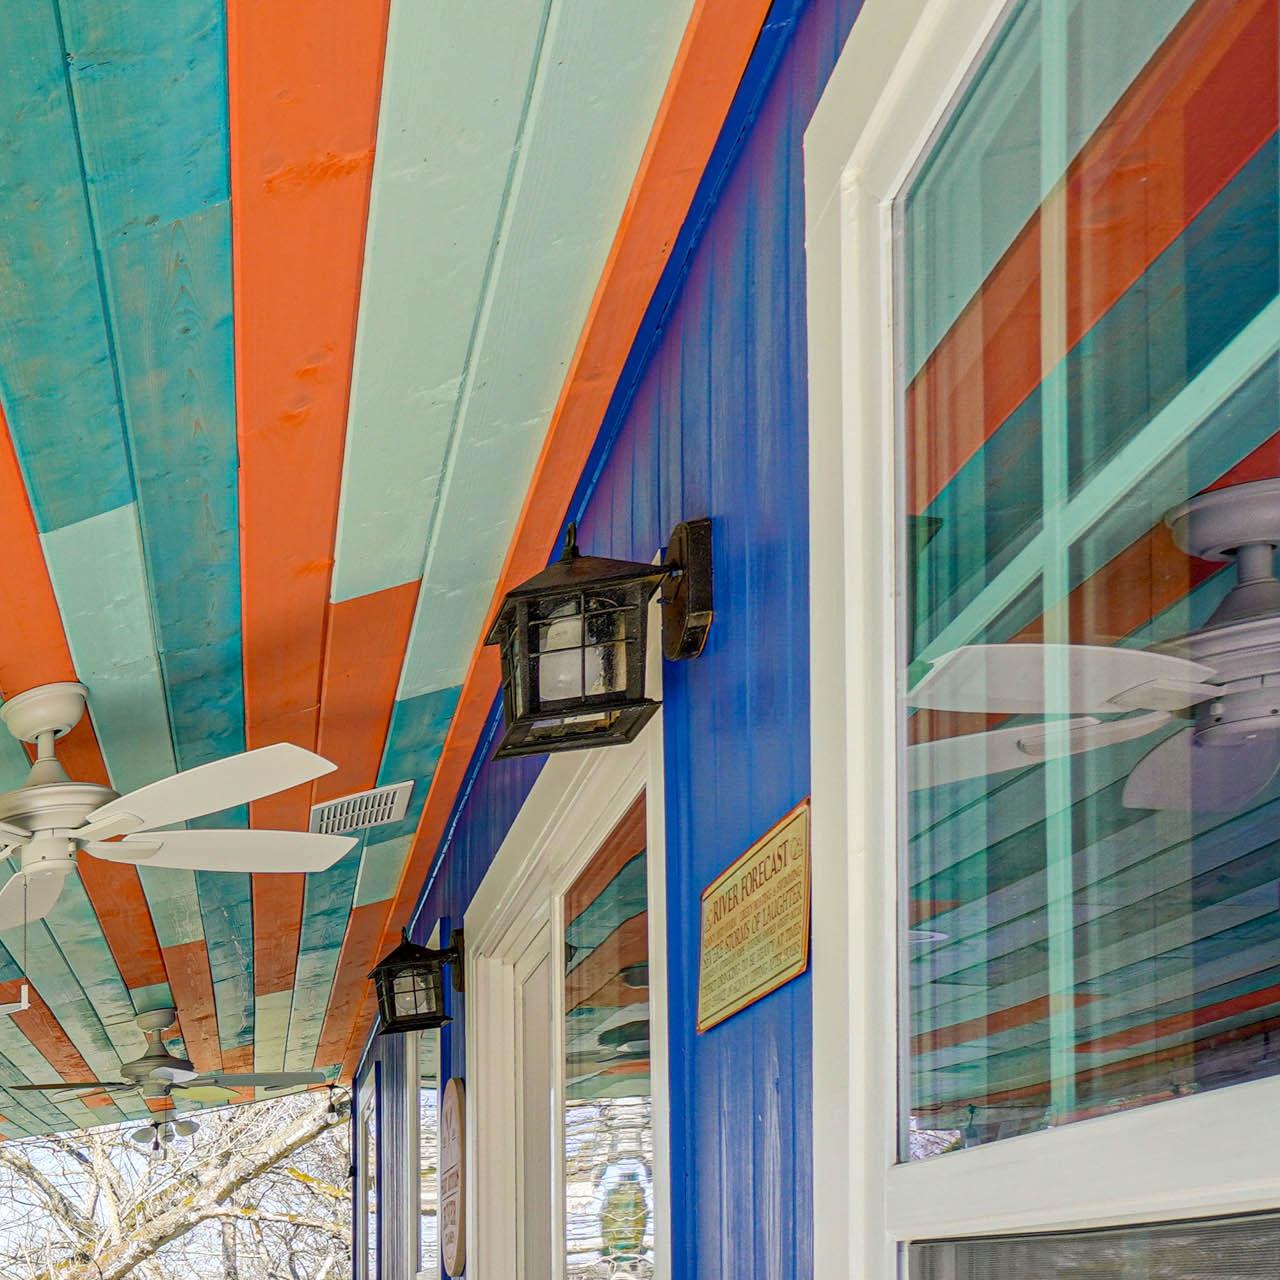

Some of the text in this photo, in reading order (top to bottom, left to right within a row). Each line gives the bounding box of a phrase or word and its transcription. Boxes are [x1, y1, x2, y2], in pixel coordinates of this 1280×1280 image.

[712, 883, 739, 925] RIVER
[740, 840, 788, 902] FORECAST
[725, 920, 749, 954] STORMS
[751, 912, 760, 935] OF
[762, 881, 802, 927] LAUGHTER
